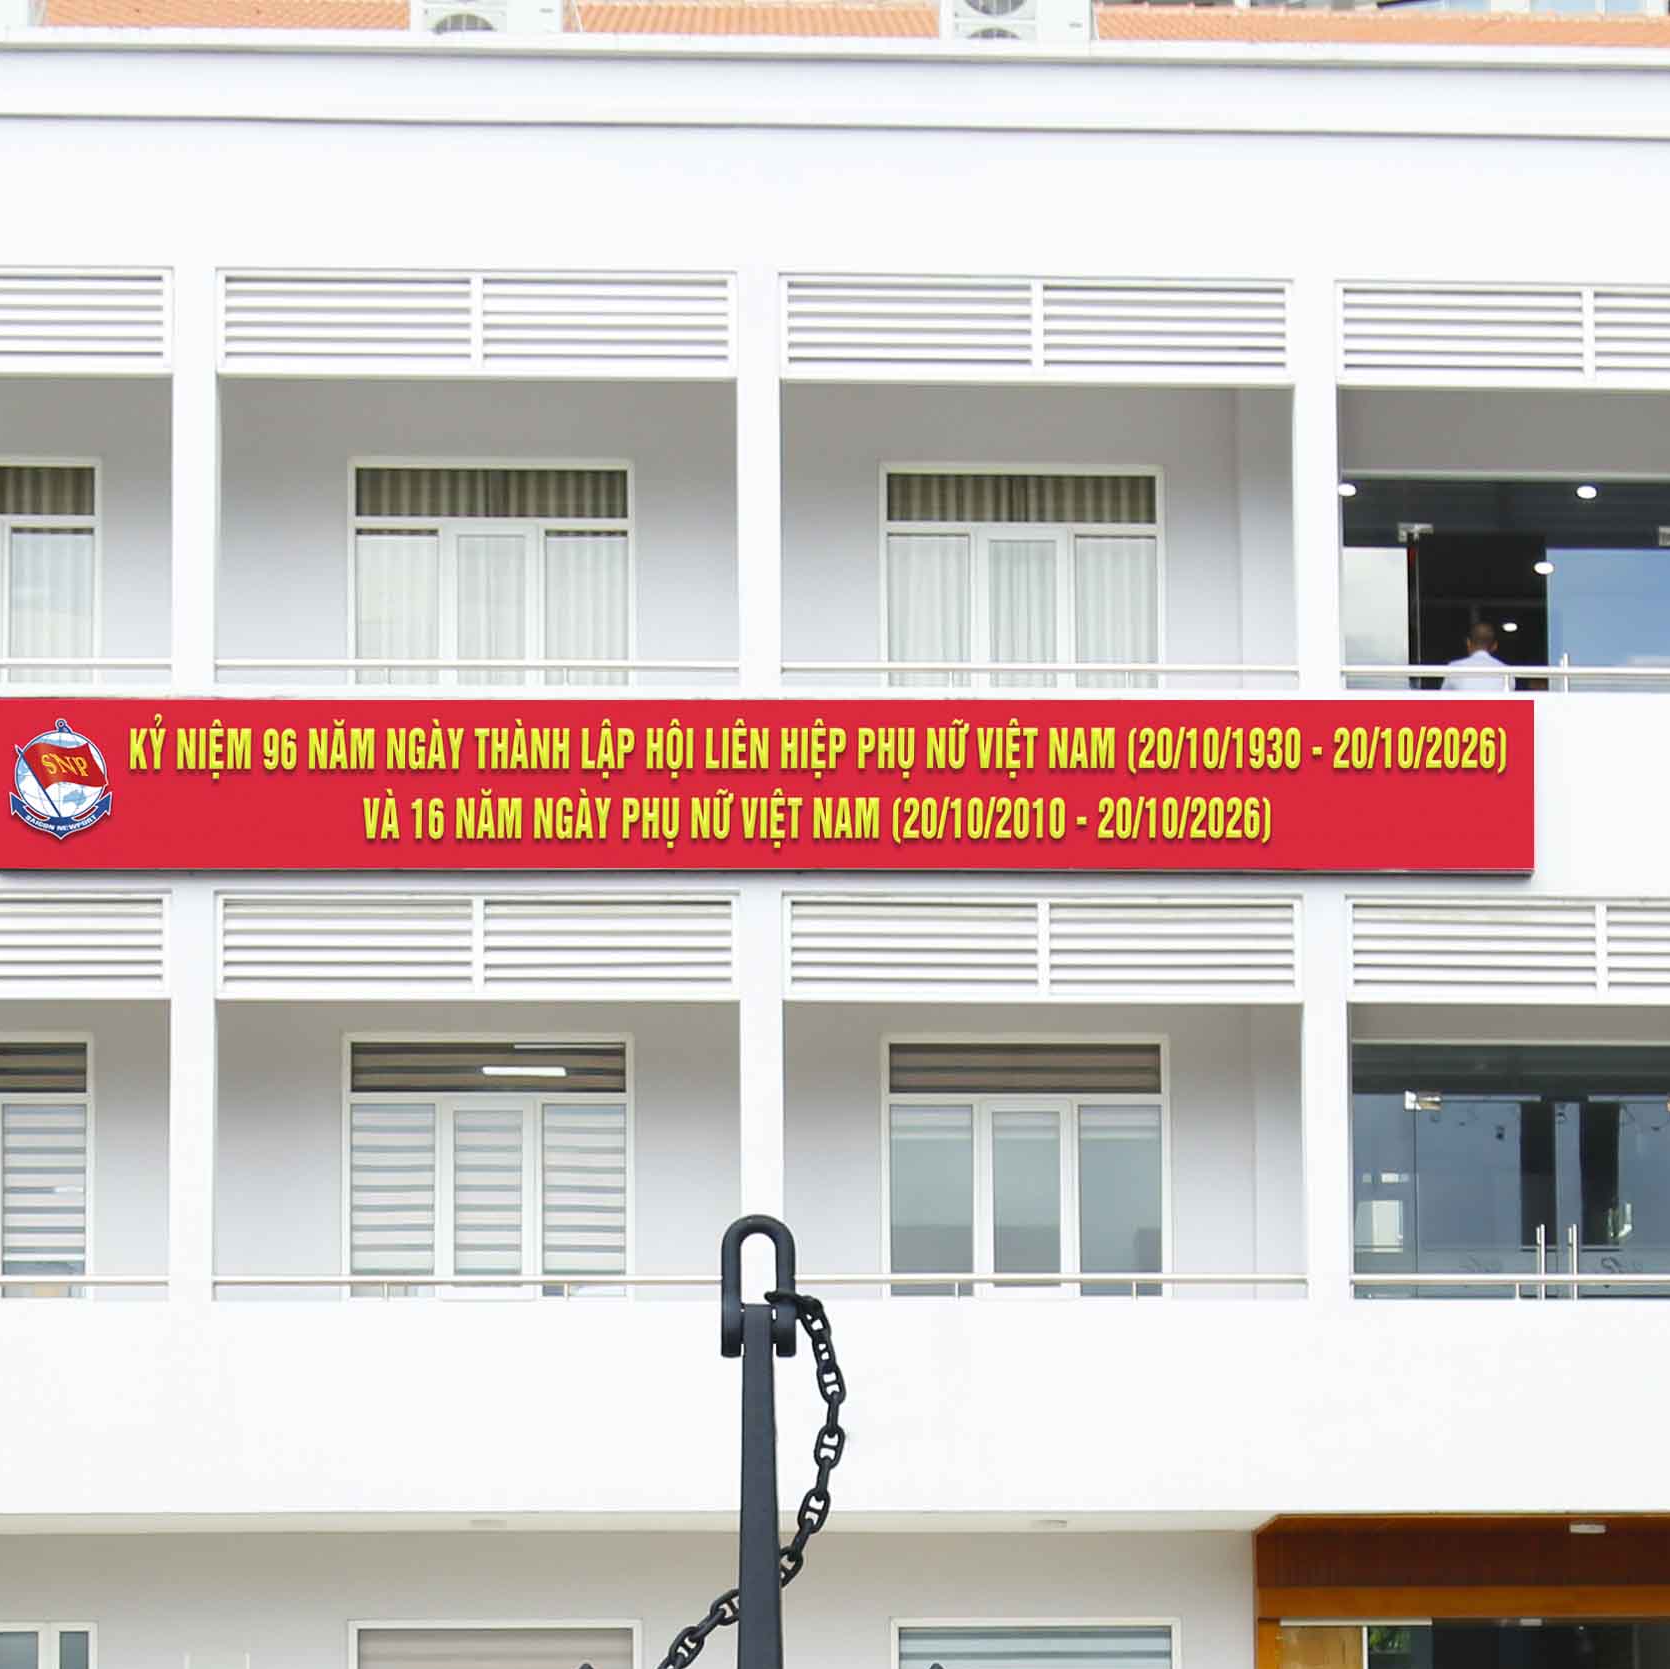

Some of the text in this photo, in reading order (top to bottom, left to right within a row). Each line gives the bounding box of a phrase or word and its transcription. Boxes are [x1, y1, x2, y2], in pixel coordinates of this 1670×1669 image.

[41, 753, 88, 776] SNP
[130, 714, 1506, 778] KỶ NIỆM 96 NĂM NGÀY THÀNH LẬP HỘI LIÊN HIỆP PHỤ NỮ VIỆT NAM (20/10/1930 - 20/10/2026)
[25, 814, 98, 831] SAIGON NEWPORT
[363, 788, 1270, 848] VÀ 16 NĂM NGÀY PHỤ NỮ VIỆT NAM (20/10/2010 - 20/10/2026)
